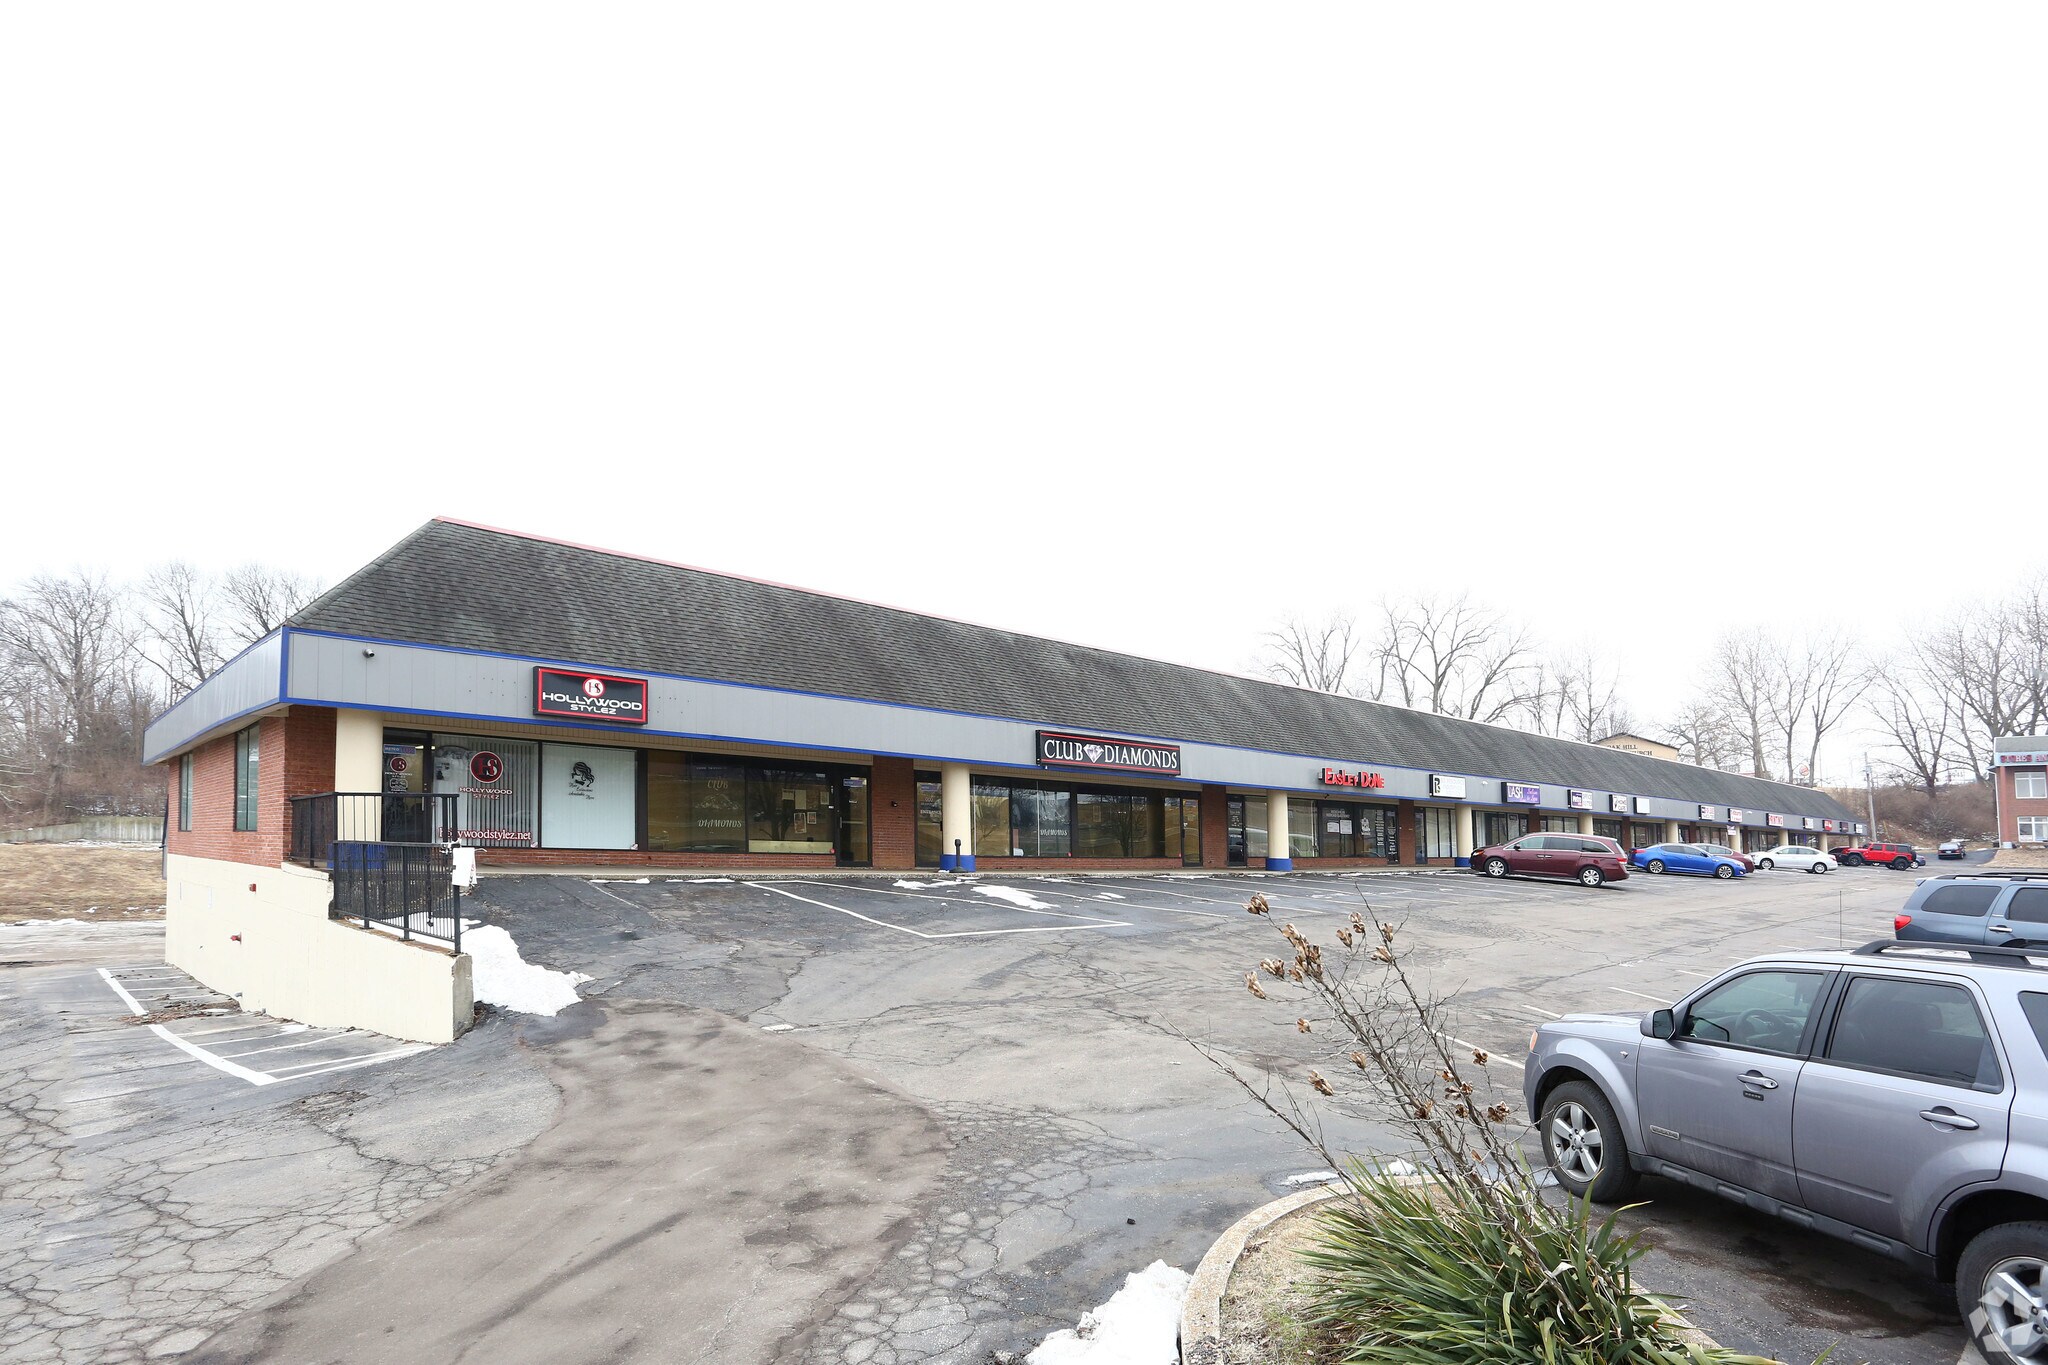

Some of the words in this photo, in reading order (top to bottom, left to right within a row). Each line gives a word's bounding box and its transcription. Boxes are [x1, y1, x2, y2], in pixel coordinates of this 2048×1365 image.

[542, 691, 643, 711] HOLLYWOOD
[570, 704, 617, 715] STYLEZ
[1044, 739, 1084, 761] CLUB
[1104, 744, 1177, 769] DIAMONDS
[459, 787, 513, 795] HOLLYWOOD
